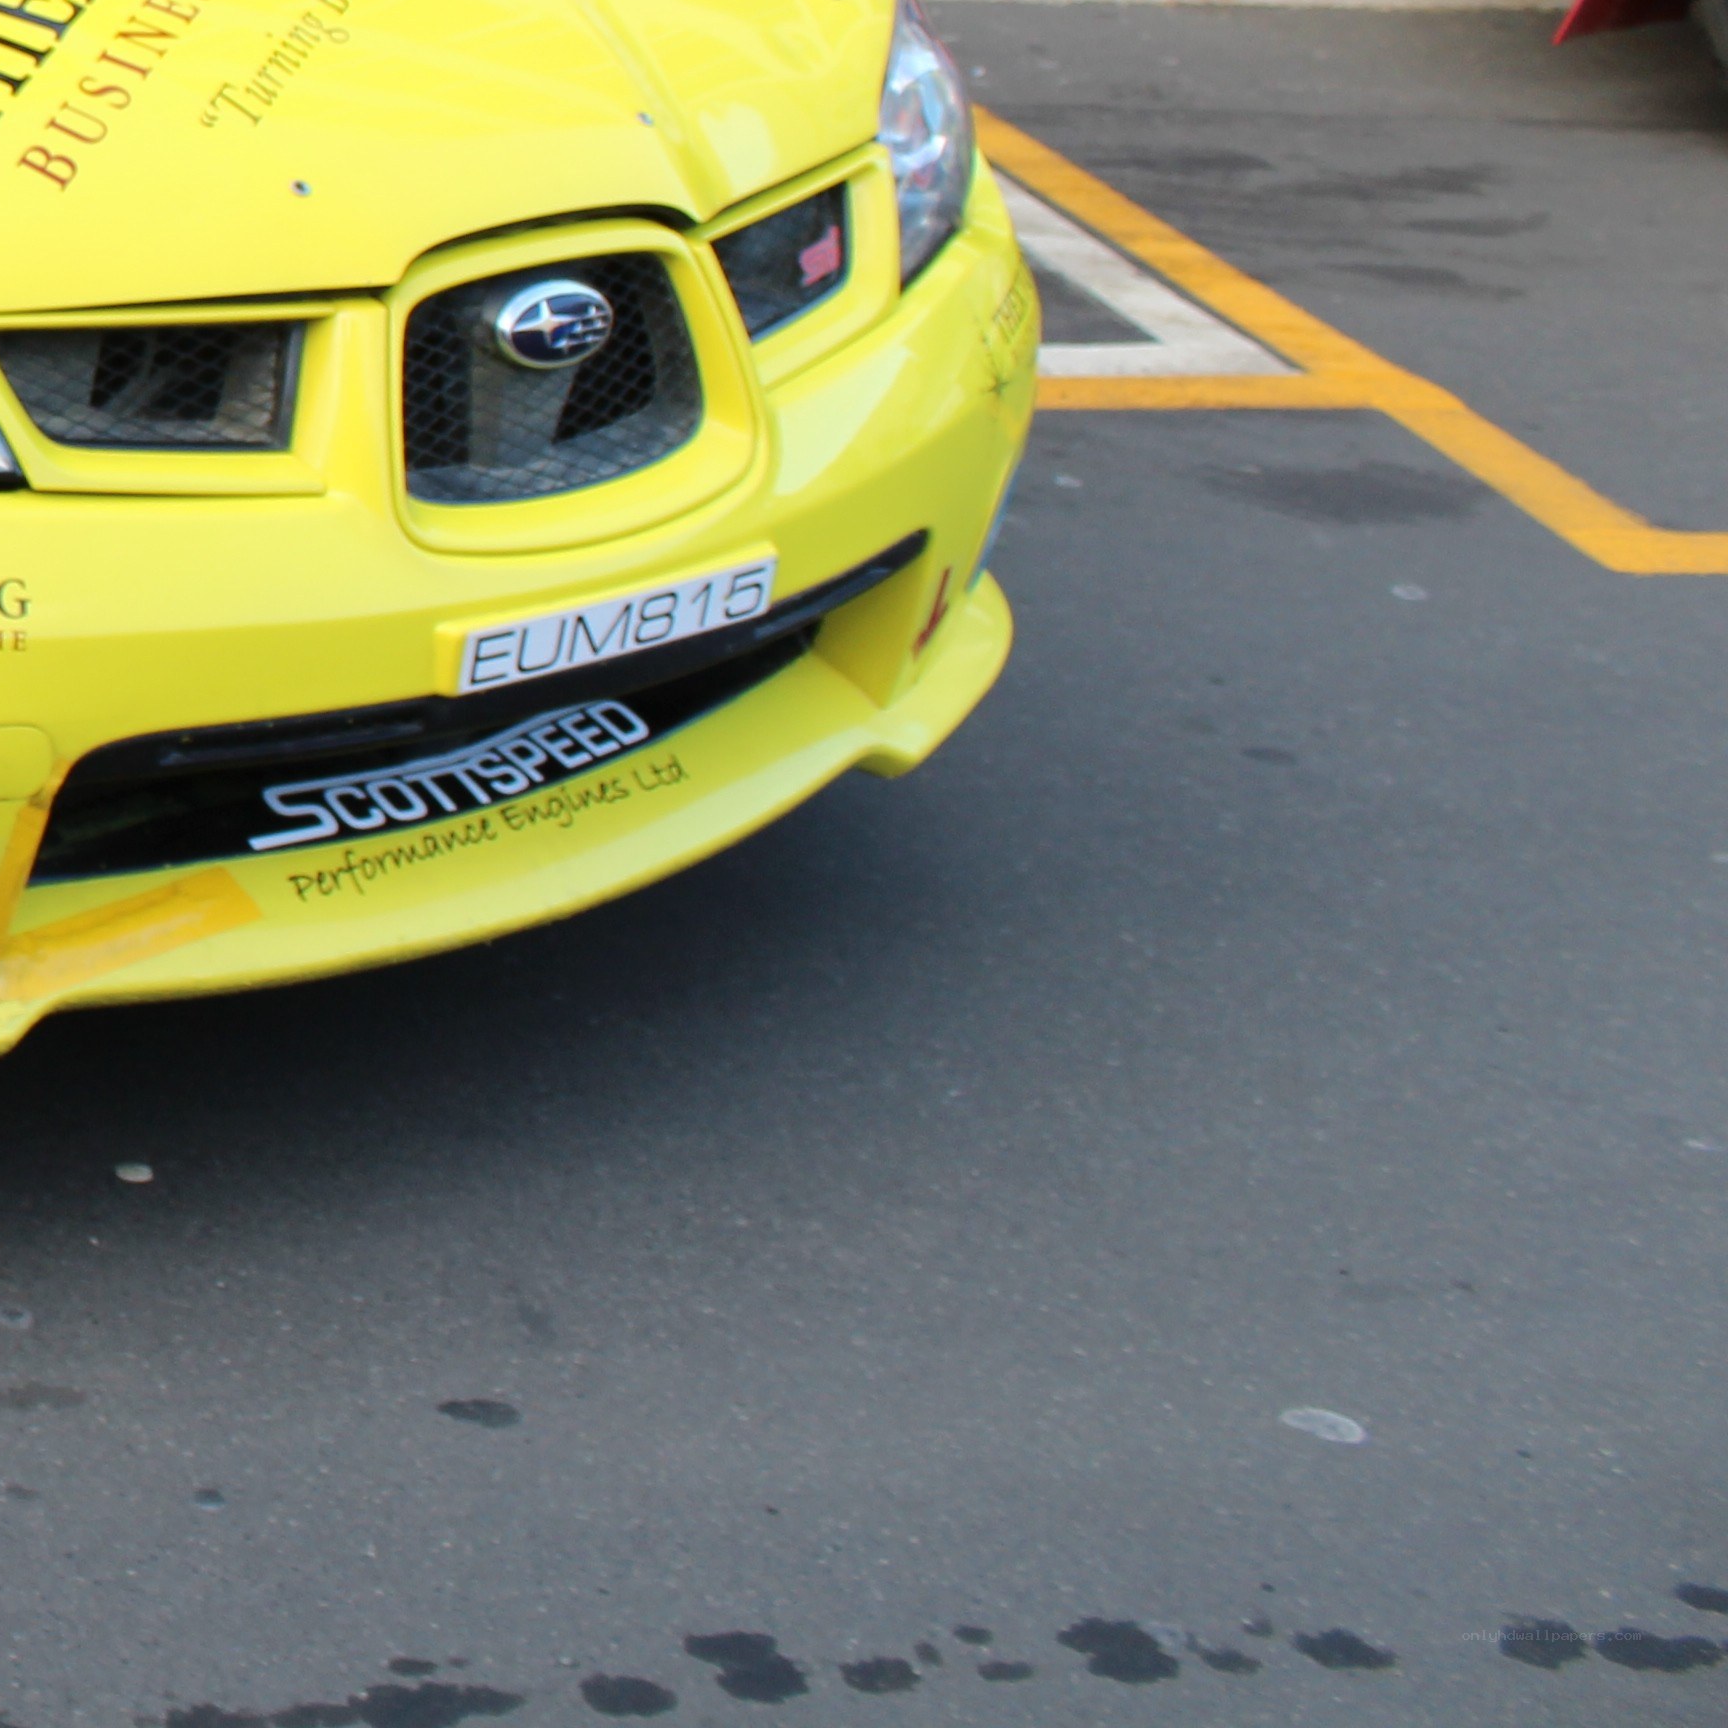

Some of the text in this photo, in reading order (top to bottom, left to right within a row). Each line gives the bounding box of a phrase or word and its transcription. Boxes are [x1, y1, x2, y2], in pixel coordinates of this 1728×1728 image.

[468, 566, 769, 686] EUM815
[247, 700, 651, 852] SCOTTSPEED
[287, 752, 690, 904] Performance Engines Ltd
